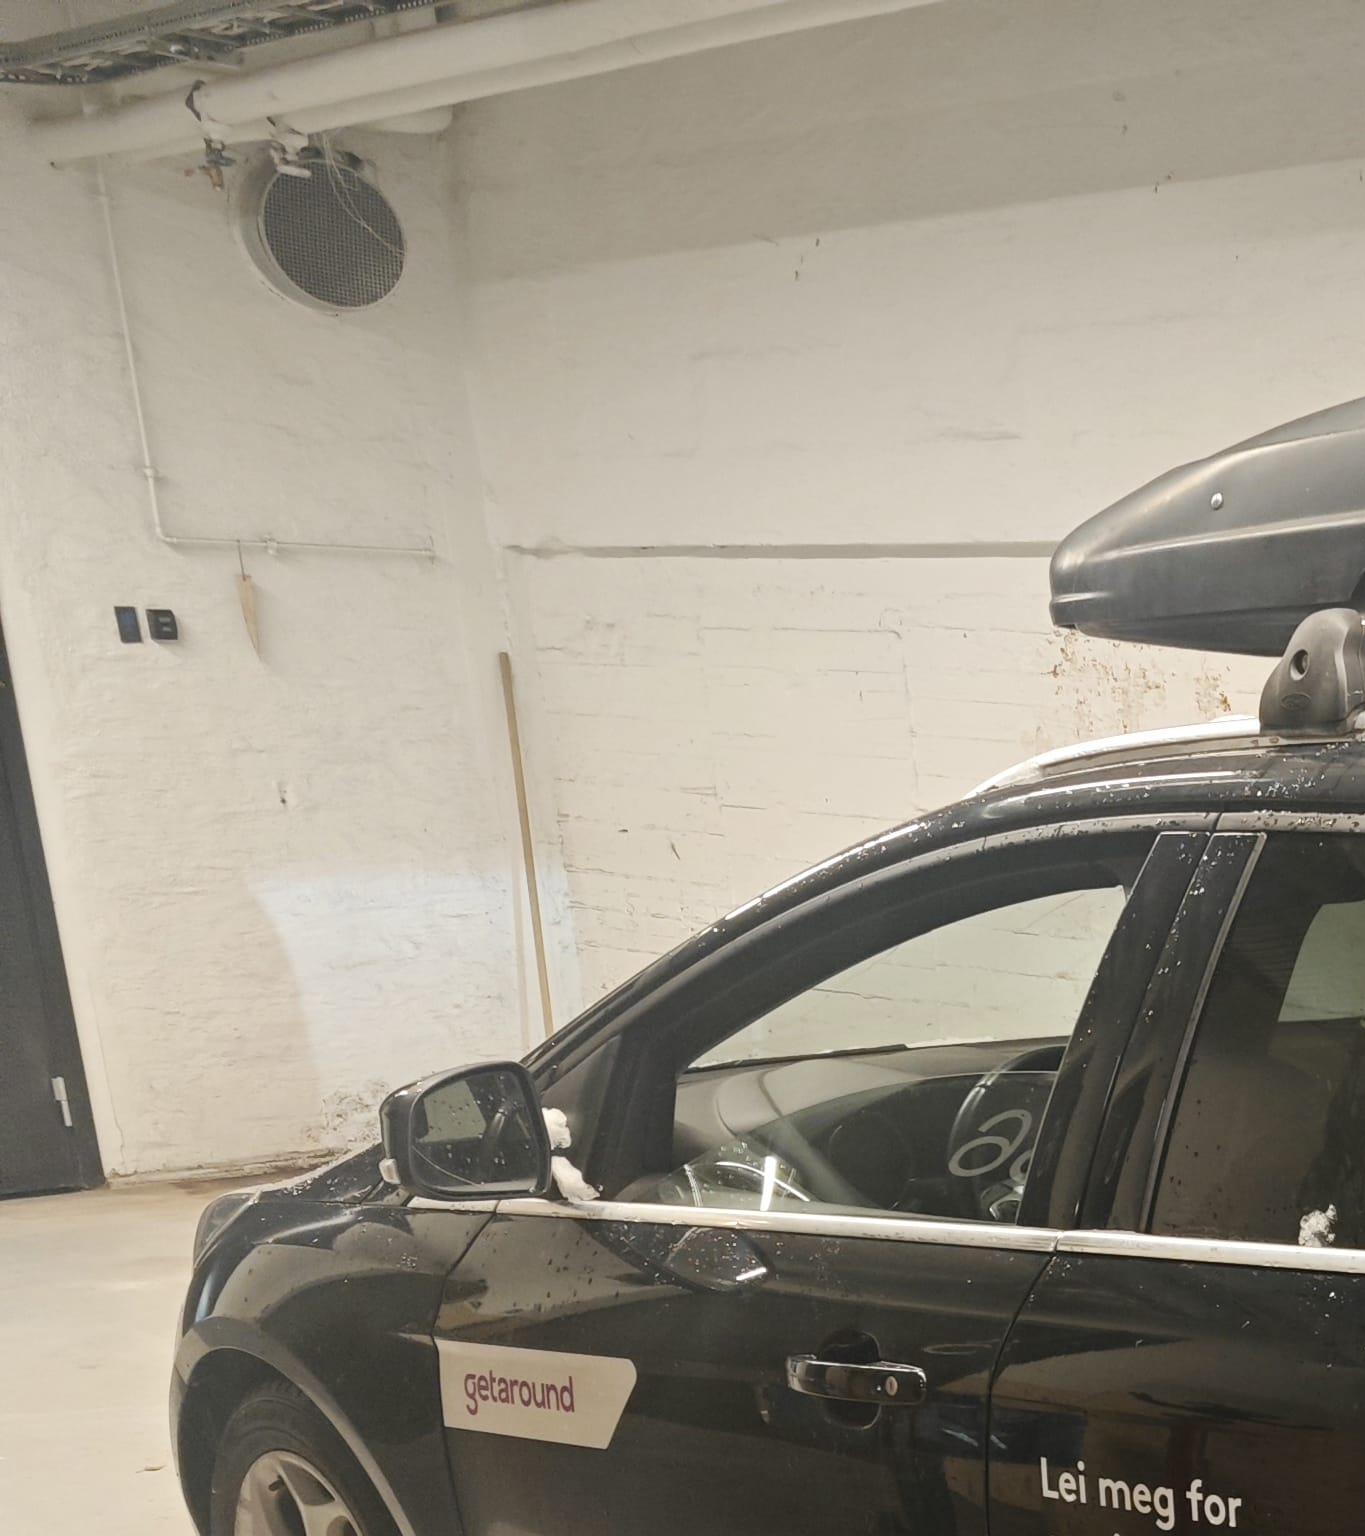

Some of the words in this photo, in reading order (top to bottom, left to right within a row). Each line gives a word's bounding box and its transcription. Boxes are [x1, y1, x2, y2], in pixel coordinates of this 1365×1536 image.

[464, 1370, 575, 1416] getaround
[1040, 1456, 1087, 1503] Lei
[1098, 1476, 1176, 1531] meg
[1185, 1478, 1242, 1528] for
